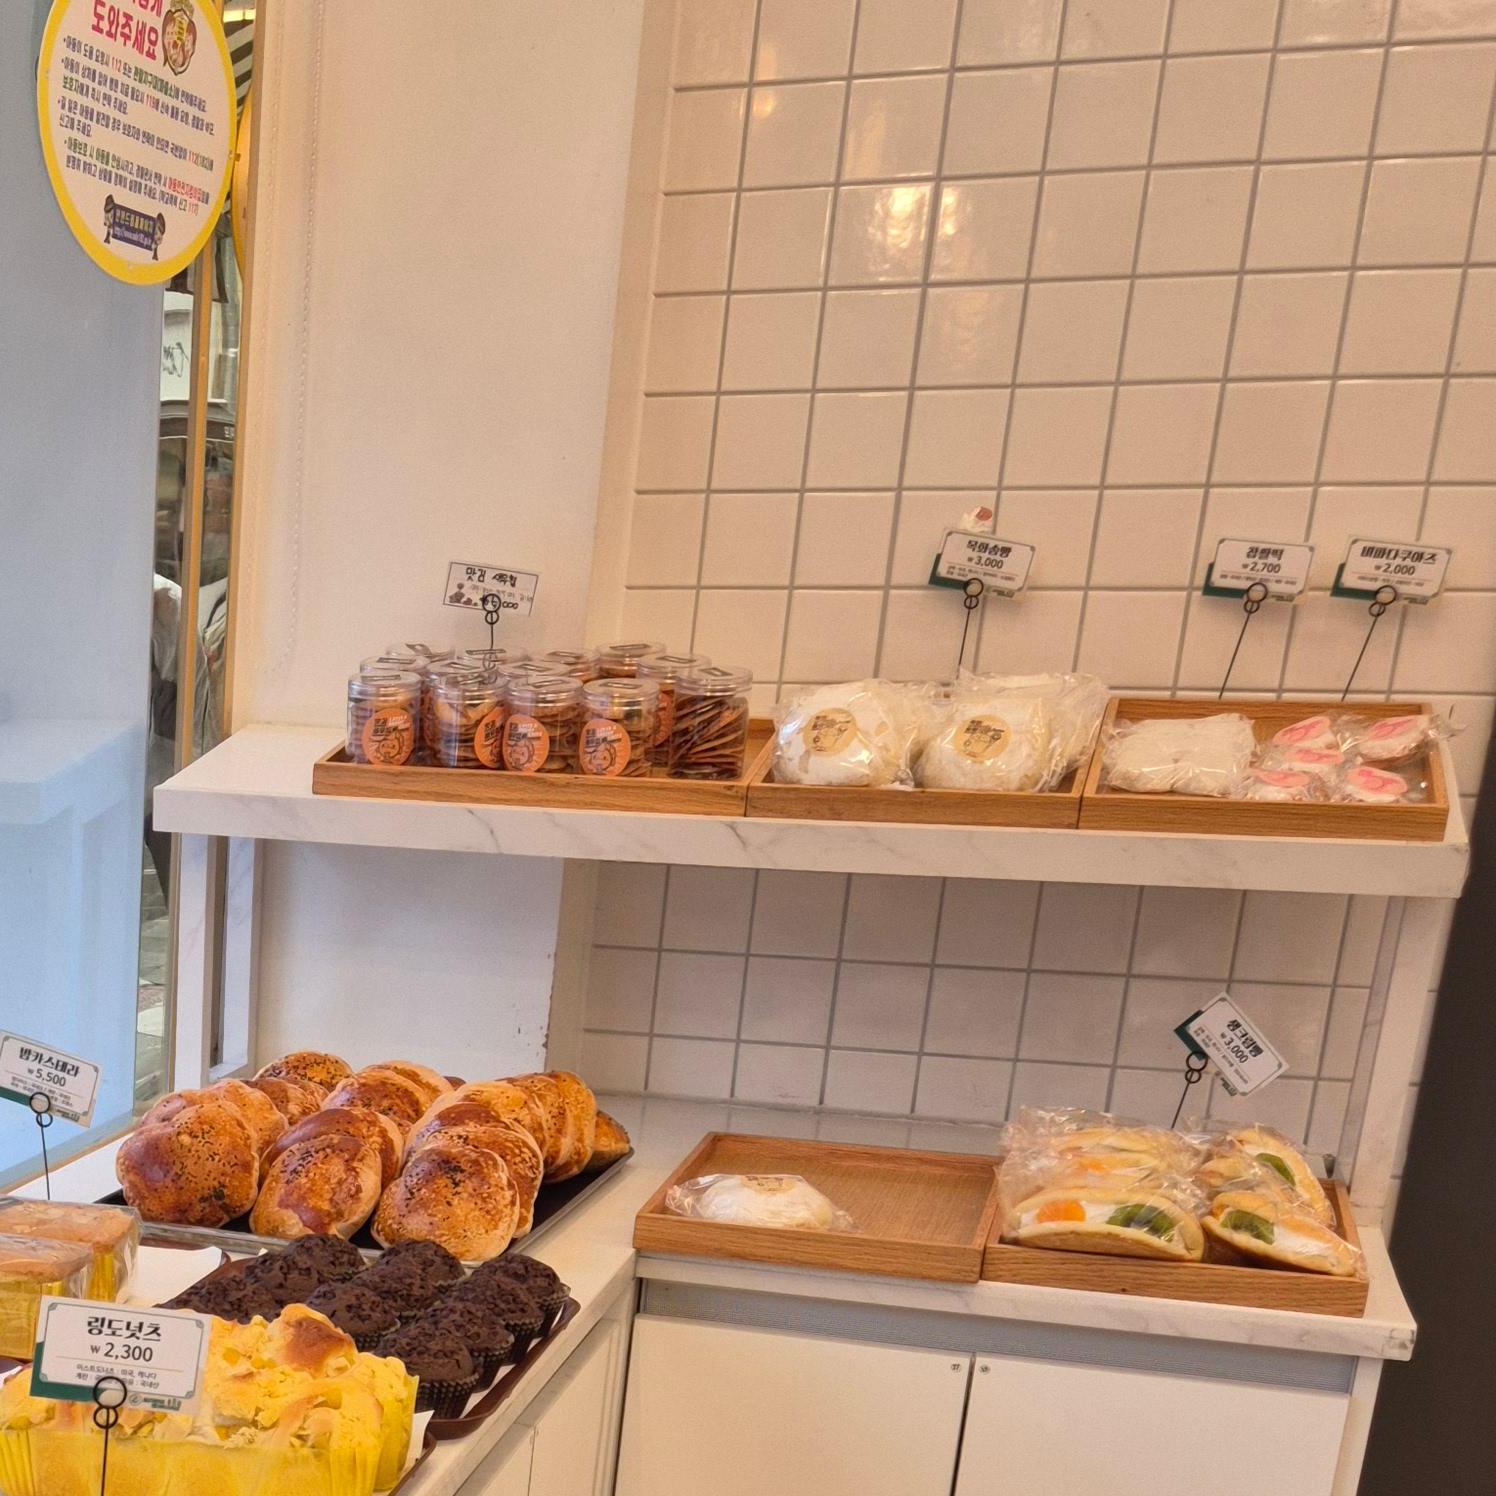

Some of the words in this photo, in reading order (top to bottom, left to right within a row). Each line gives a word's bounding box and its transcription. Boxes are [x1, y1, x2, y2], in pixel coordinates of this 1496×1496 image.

[91, 0, 158, 60] 도와주세요
[111, 57, 122, 72] 112
[974, 556, 1004, 569] 3,000
[1249, 562, 1281, 574] 2,700
[1382, 563, 1415, 576] 2,000
[1224, 1037, 1249, 1063] 3,000
[19, 1047, 80, 1077] 밤카스테라
[35, 1069, 66, 1087] 5,500
[87, 1316, 162, 1342] 링도넛츠
[104, 1342, 153, 1362] 2,300
